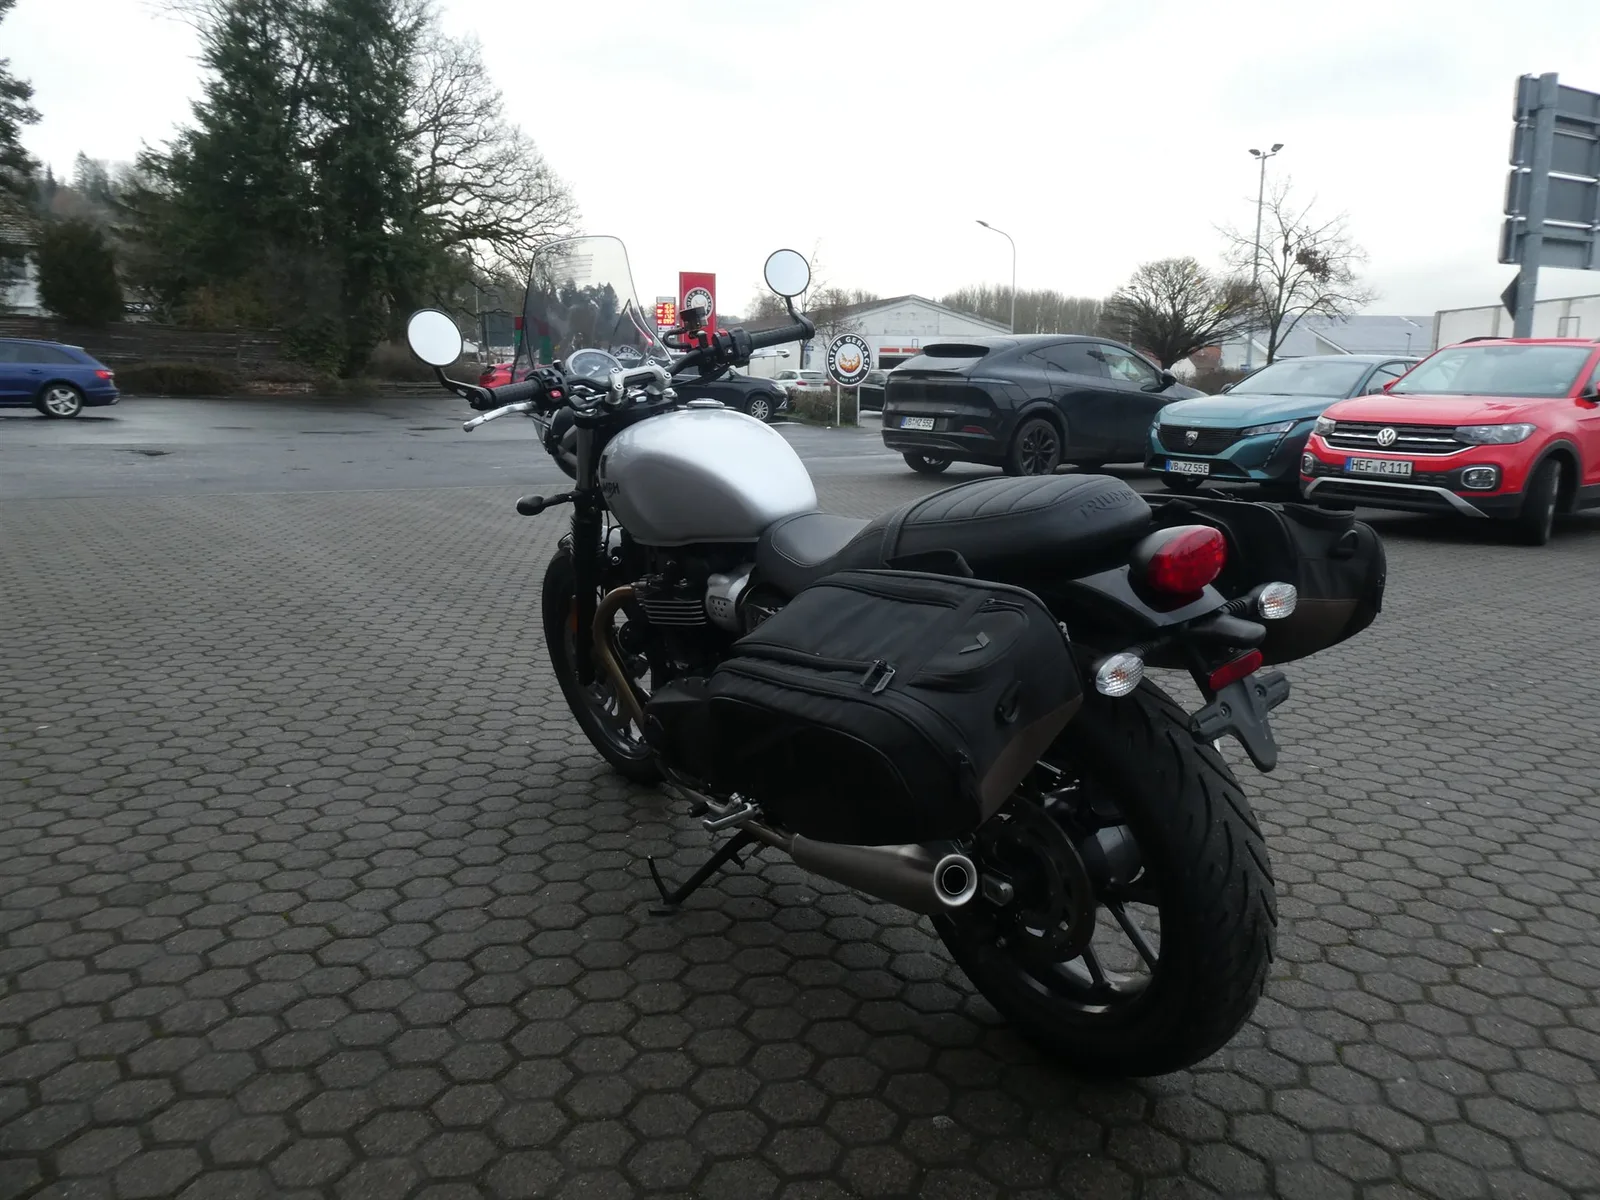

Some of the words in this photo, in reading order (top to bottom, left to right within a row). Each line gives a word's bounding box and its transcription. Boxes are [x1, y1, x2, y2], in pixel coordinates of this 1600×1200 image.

[828, 340, 843, 371] GUTER
[845, 336, 870, 371] GERLACH
[1170, 461, 1178, 471] VB
[1183, 463, 1192, 472] ZZ
[1193, 464, 1209, 474] 55E
[1351, 459, 1373, 471] HEF
[1379, 461, 1387, 473] R
[1389, 462, 1409, 475] 111
